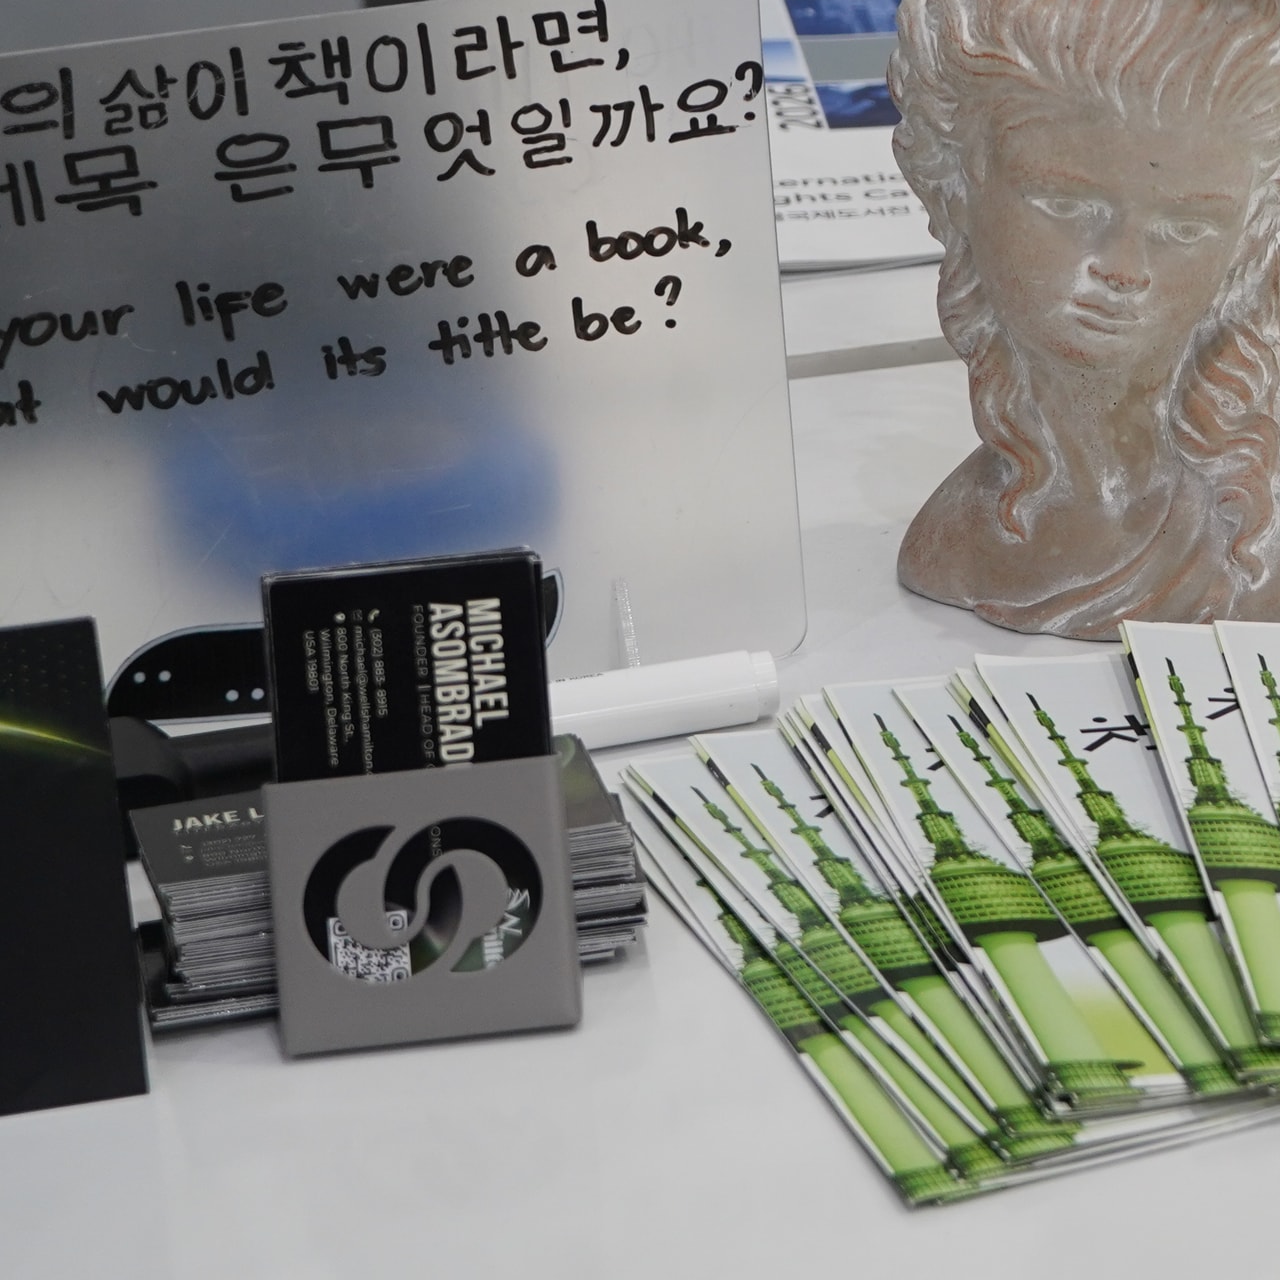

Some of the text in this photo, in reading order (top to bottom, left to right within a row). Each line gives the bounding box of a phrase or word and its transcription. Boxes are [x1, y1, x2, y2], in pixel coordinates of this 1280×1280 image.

[175, 280, 288, 341] life
[337, 252, 475, 300] were
[515, 242, 558, 277] a
[586, 207, 732, 263] book,
[98, 349, 276, 413] would
[321, 336, 388, 379] its
[304, 631, 319, 692] USA 19801
[337, 627, 348, 651] 800
[466, 597, 509, 729] MICHAEL
[320, 629, 340, 766] Wilmington, Delaware
[338, 654, 352, 690] North
[370, 629, 383, 657] (302)
[377, 689, 388, 716] 8915
[428, 602, 474, 768] ASOMBRAD
[341, 692, 352, 721] King
[420, 693, 433, 735] HEAD
[423, 739, 435, 759] OF
[174, 810, 240, 831] JAKE
